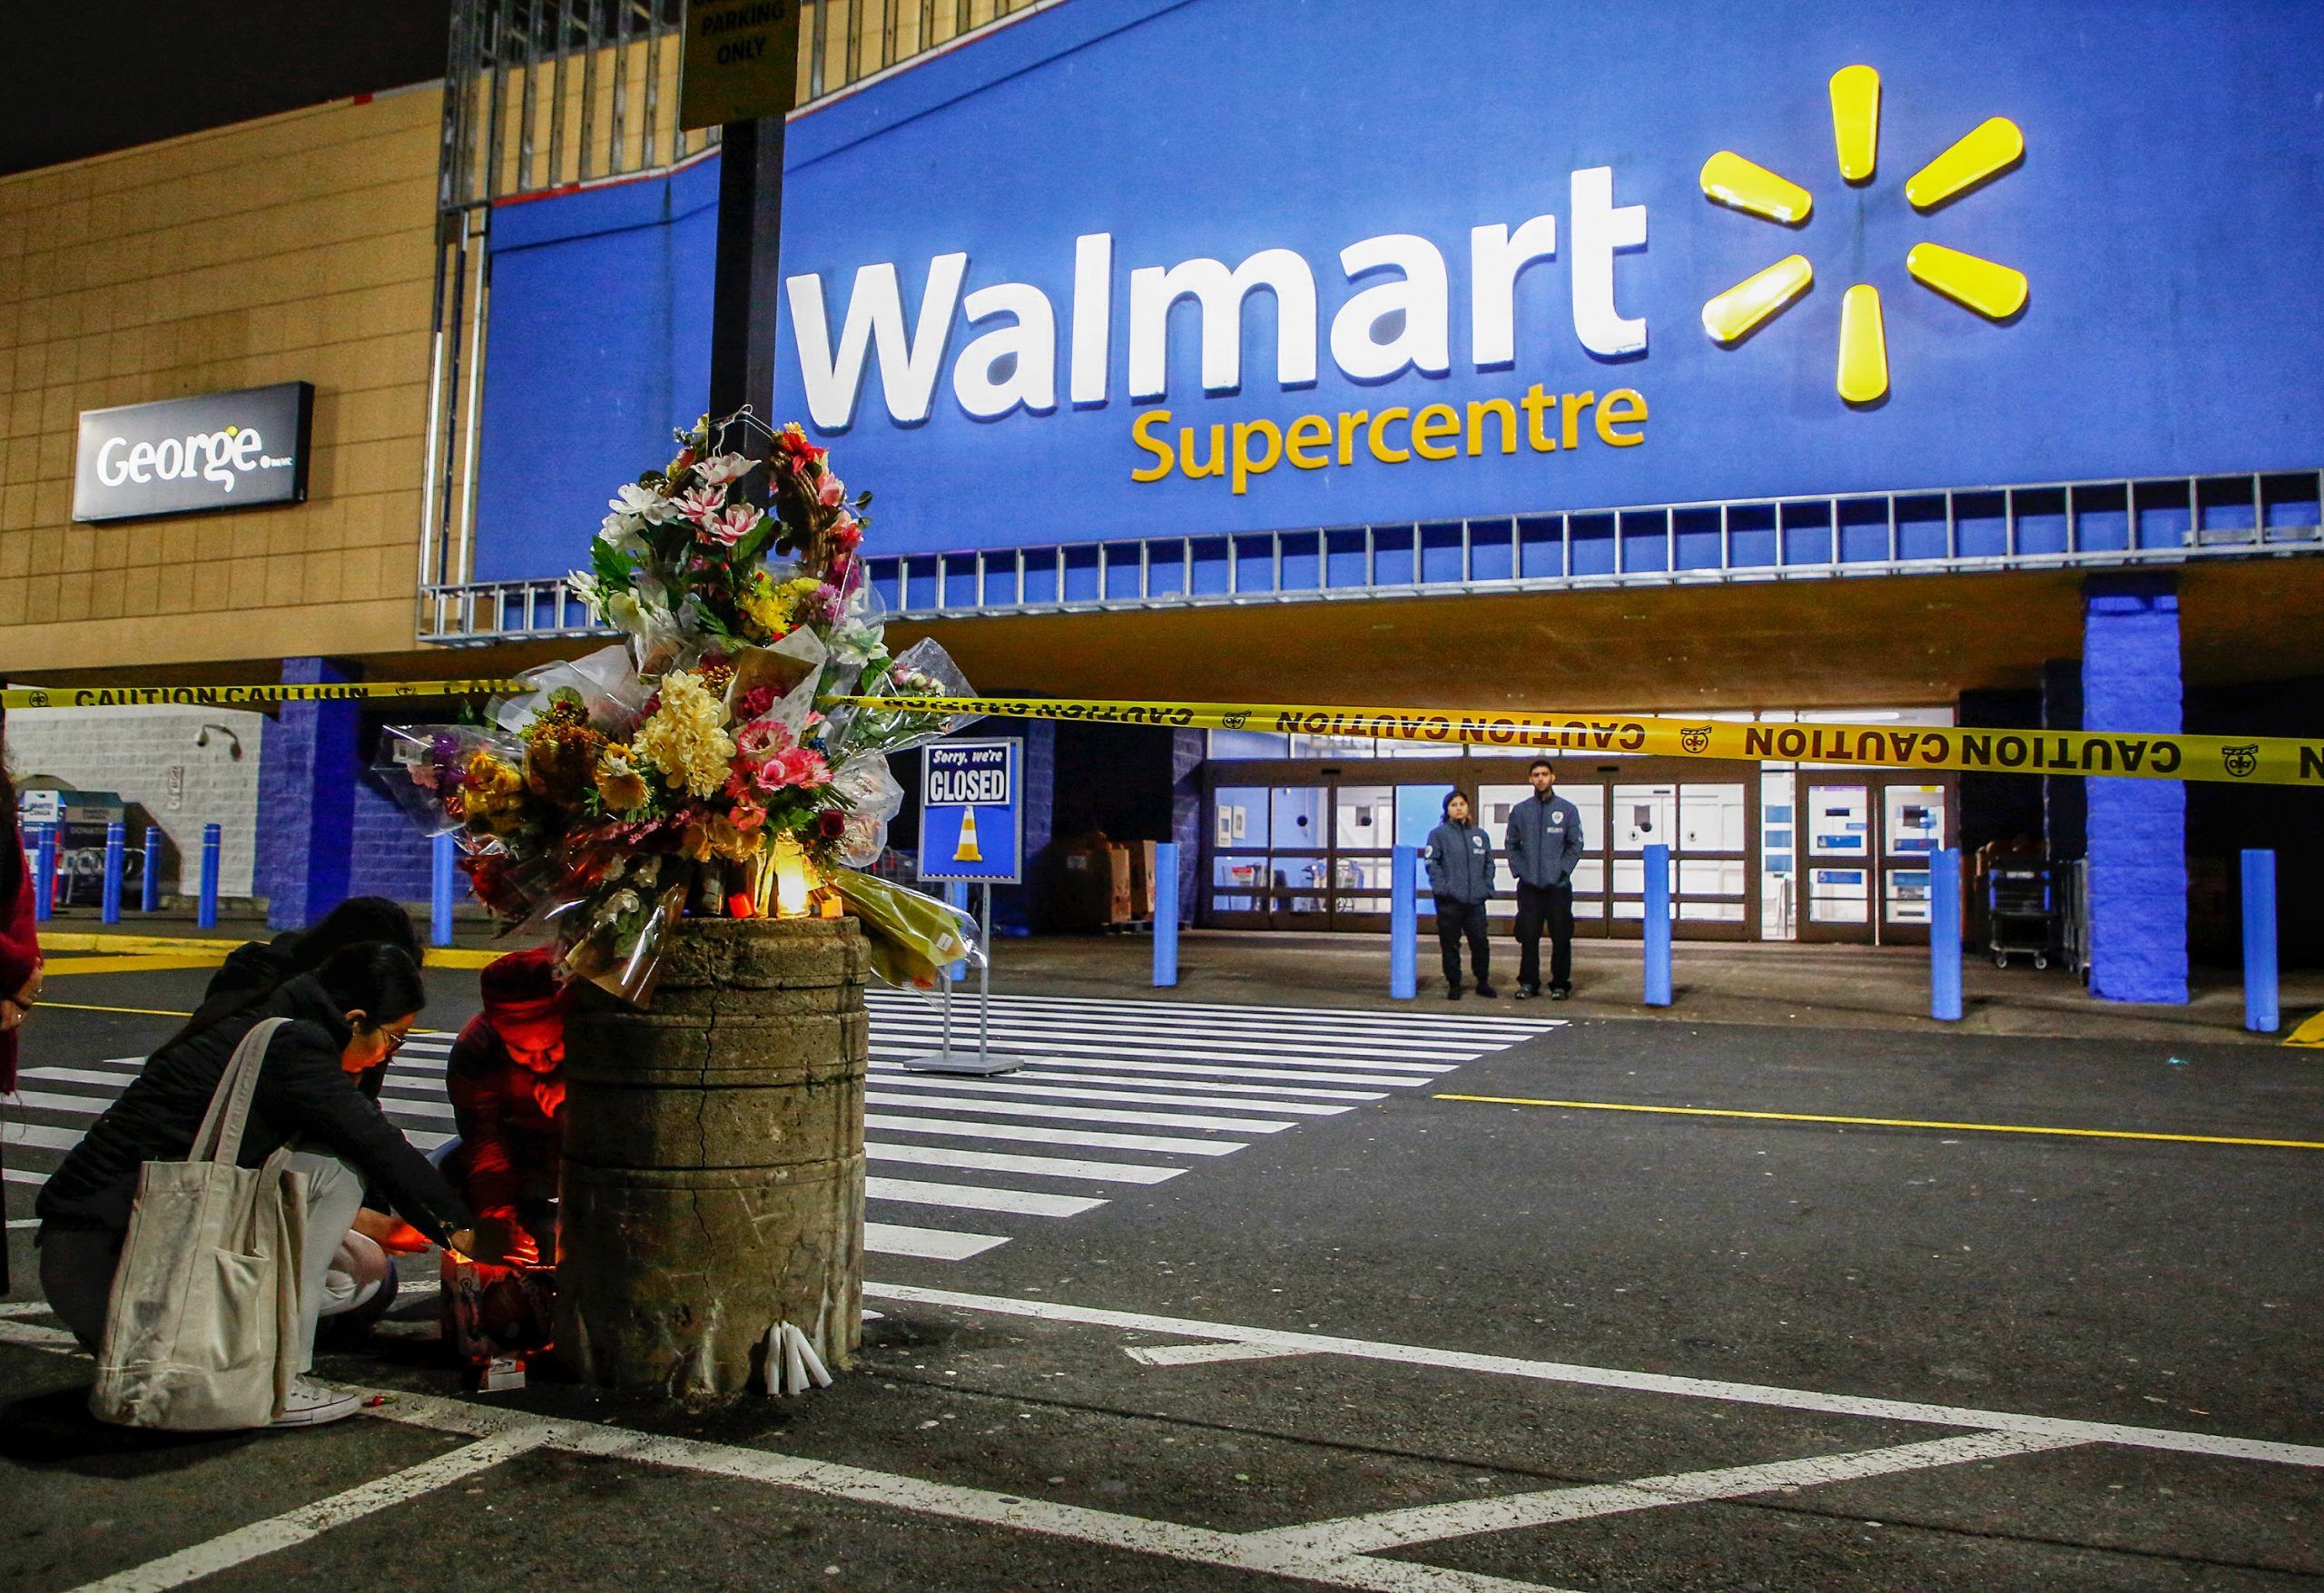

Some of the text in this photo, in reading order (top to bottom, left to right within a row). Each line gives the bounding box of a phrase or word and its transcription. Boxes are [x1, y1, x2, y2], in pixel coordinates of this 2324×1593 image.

[702, 5, 784, 36] PARKING
[717, 36, 766, 64] ONLY
[785, 166, 1649, 431] Walmart
[1130, 382, 1649, 495] Supercentre
[74, 687, 216, 706] CAUTION
[1036, 703, 1195, 725] CAUTION
[1275, 711, 1646, 750] CAUTION CAUTION
[932, 750, 1003, 766] Sorry, we're
[1744, 727, 2181, 773] CAUTION CAUTION
[930, 770, 1005, 801] CLOSED
